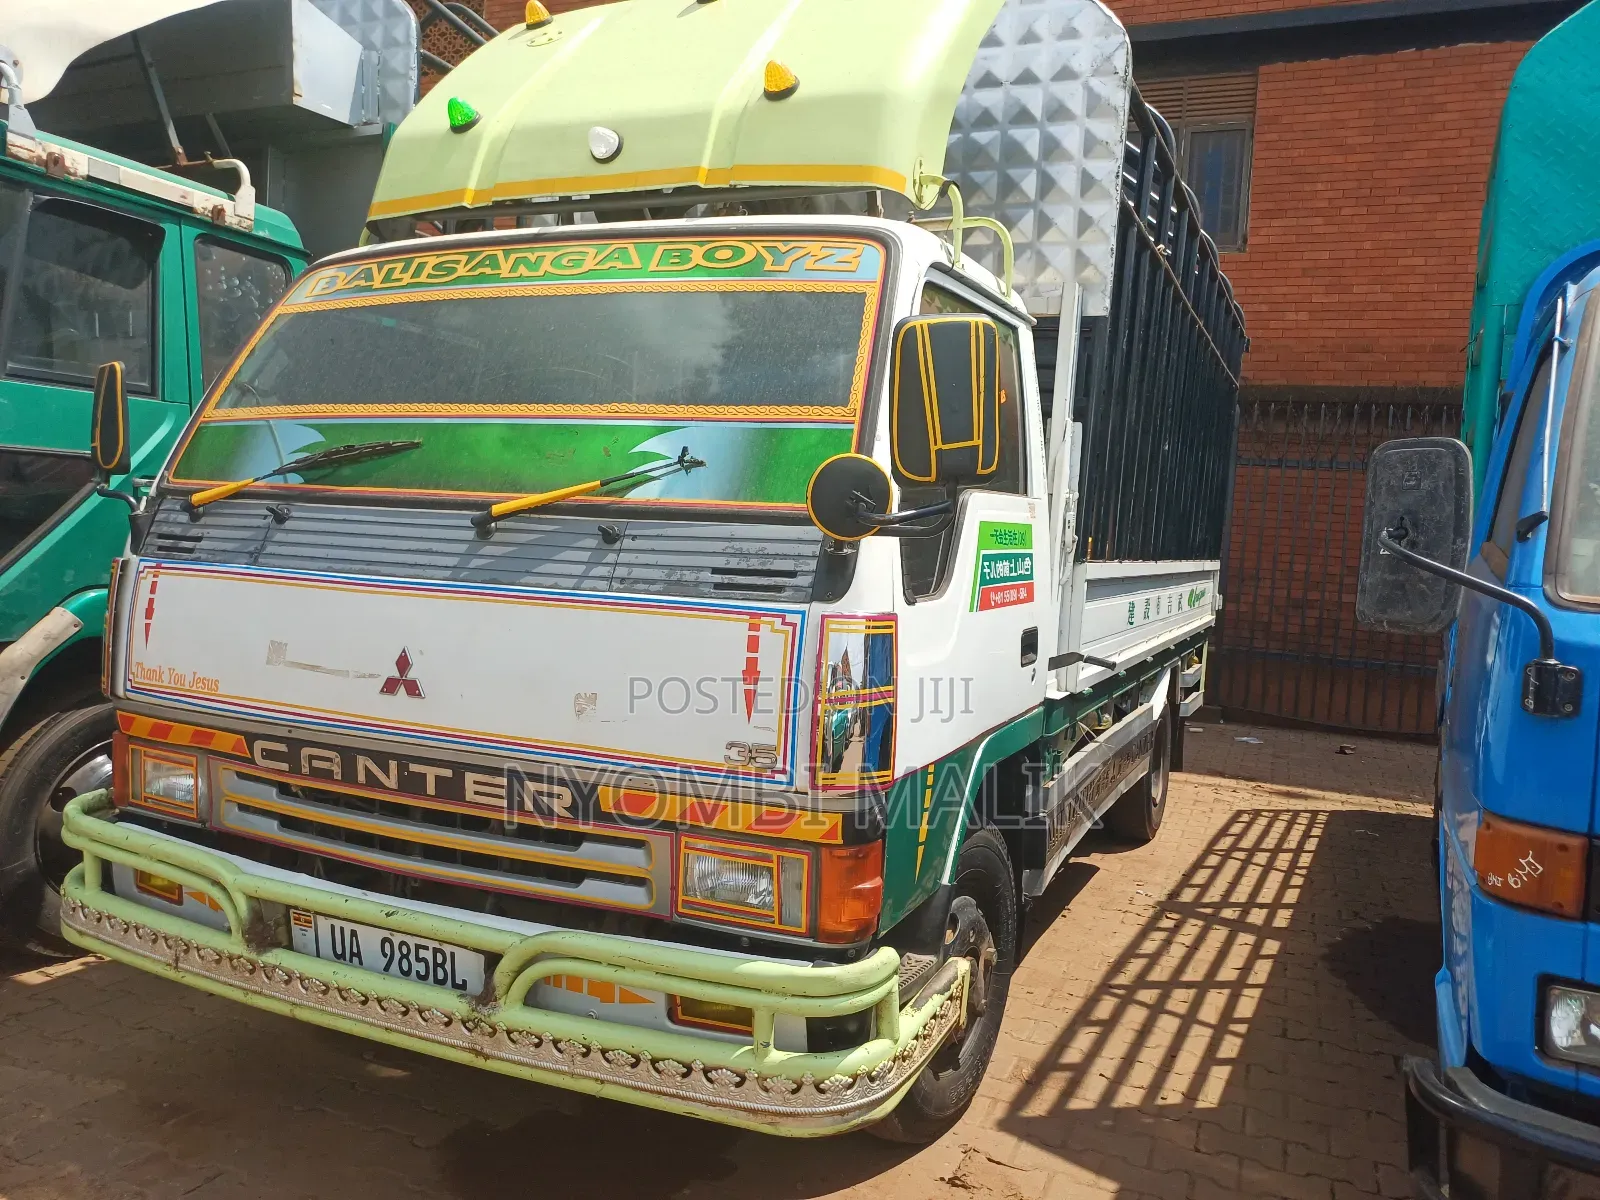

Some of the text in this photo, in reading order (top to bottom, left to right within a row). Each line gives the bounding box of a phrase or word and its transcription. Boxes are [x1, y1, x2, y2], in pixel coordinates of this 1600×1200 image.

[303, 239, 866, 298] BALISANGA BOYZ
[134, 661, 220, 693] Thank You Jesus
[252, 738, 576, 820] CANTER
[723, 740, 778, 770] 35
[330, 923, 468, 992] UA 985BL
